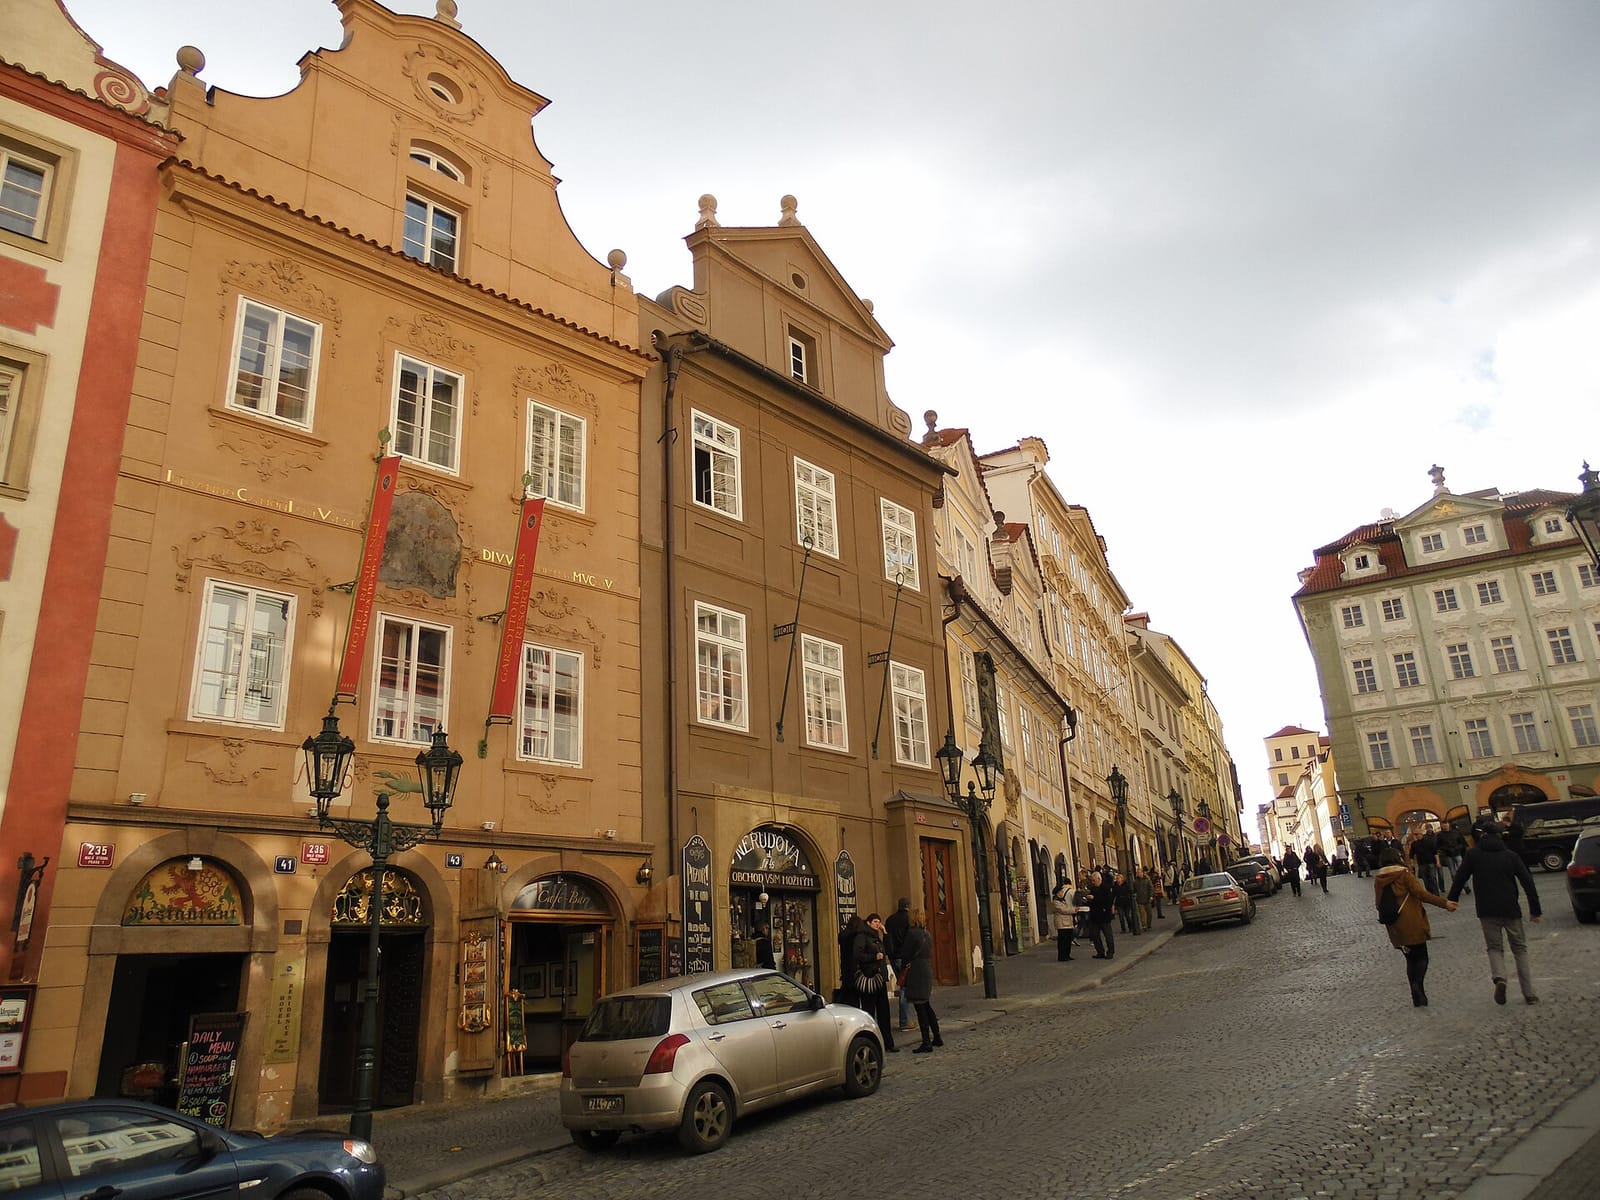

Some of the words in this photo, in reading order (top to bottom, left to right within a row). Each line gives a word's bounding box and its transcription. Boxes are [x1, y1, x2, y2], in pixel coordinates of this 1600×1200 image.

[514, 578, 531, 640] RESORTS
[499, 607, 518, 683] GARZOTTO
[510, 552, 527, 607] HOTELS
[349, 608, 363, 656] HOTEL
[87, 845, 108, 855] 235
[309, 844, 324, 854] 236
[735, 831, 800, 868] NERUDOVA
[280, 859, 292, 870] 41
[450, 855, 460, 865] 43
[731, 870, 764, 883] OBCHOD
[129, 905, 238, 921] Restaurant
[277, 995, 285, 1025] HOTEL
[284, 983, 294, 1036] RESIDENCE
[192, 1031, 222, 1044] DAILY
[208, 1041, 235, 1054] MENU
[198, 1054, 218, 1063] SOUP
[189, 1096, 208, 1107] SOUP
